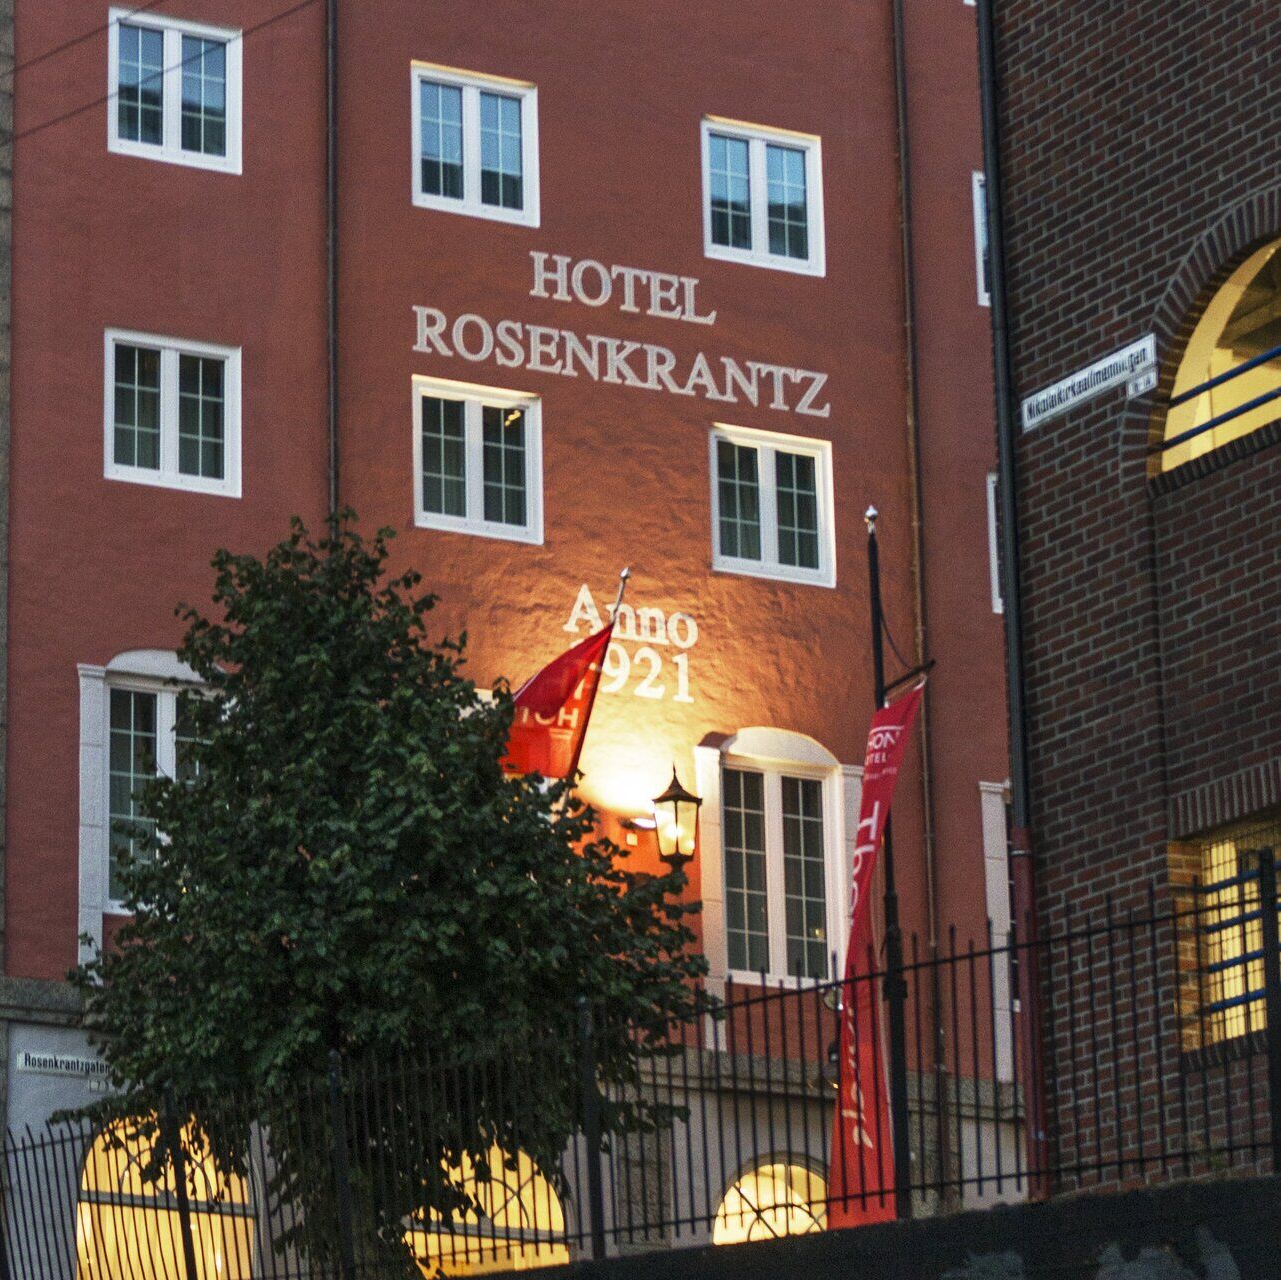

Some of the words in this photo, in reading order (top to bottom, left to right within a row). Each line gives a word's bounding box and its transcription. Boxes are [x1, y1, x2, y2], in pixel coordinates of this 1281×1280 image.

[529, 251, 717, 325] HOTEL
[411, 305, 831, 418] ROSENKRANTZ
[562, 583, 699, 649] Anno
[569, 638, 695, 704] 921
[24, 1053, 110, 1075] Rosenkrantzgaten
